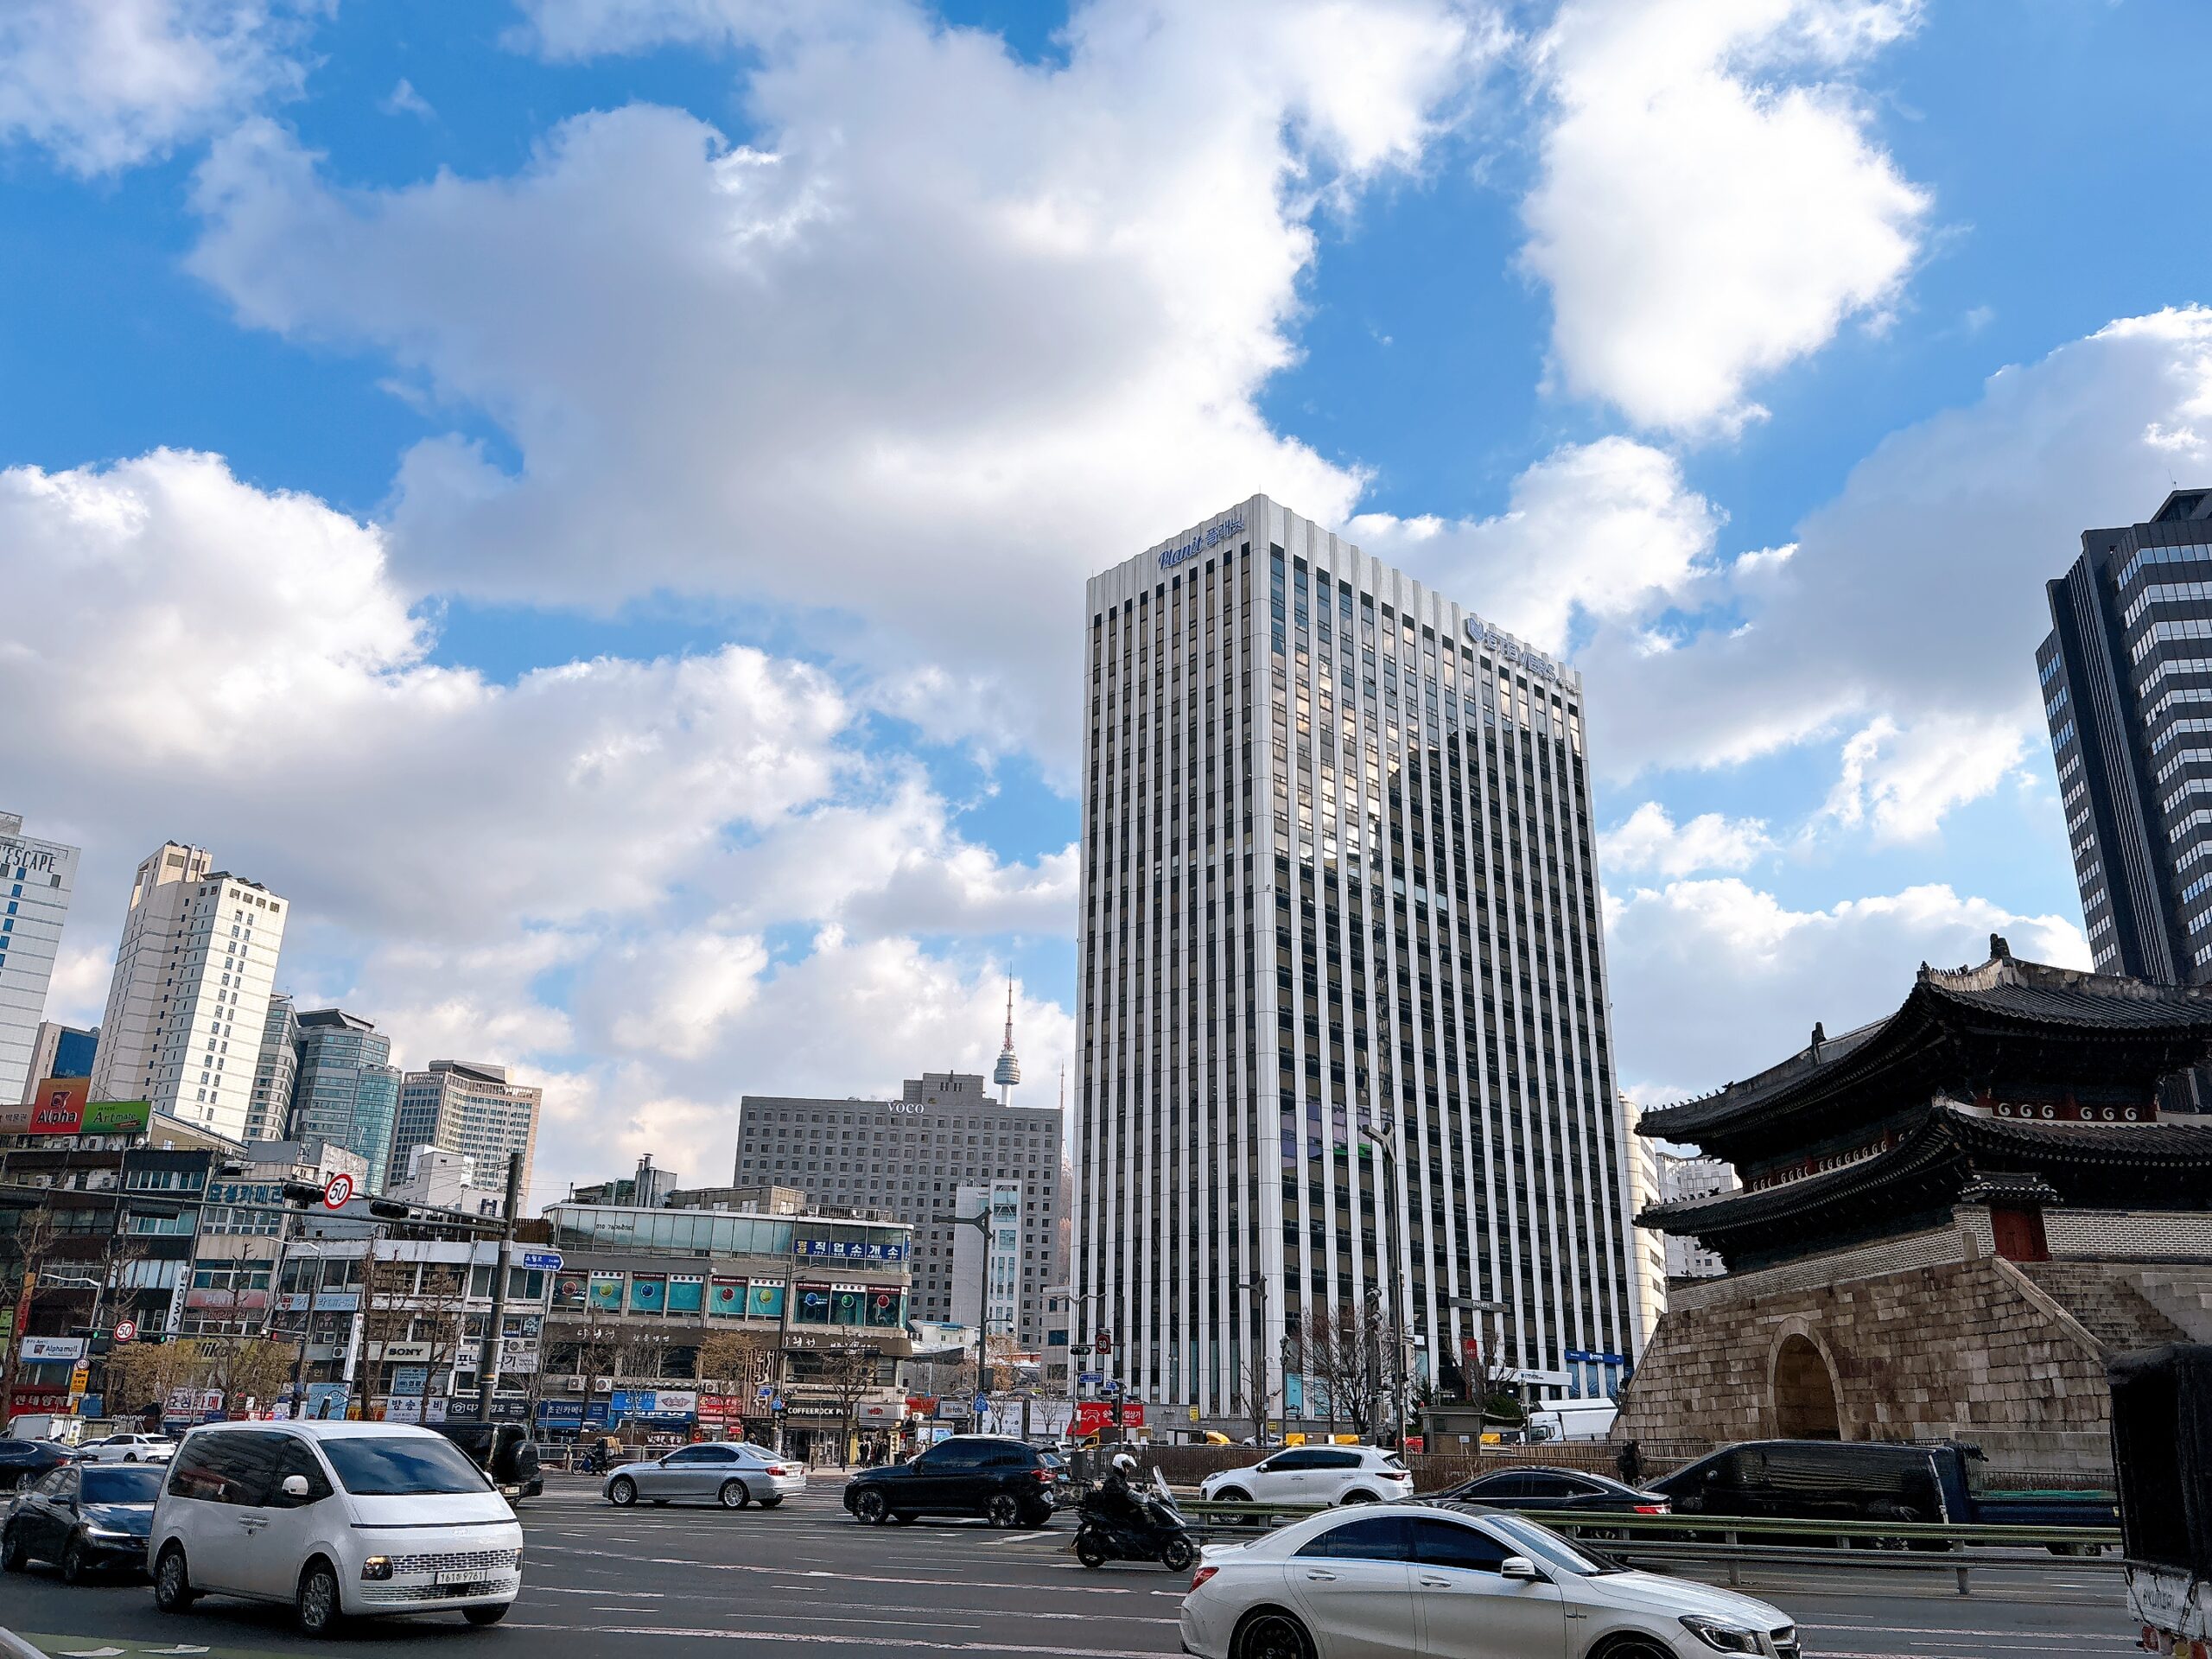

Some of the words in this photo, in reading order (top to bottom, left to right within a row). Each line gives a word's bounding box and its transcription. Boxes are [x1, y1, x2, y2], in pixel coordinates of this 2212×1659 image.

[1159, 535, 1203, 570] Planit
[1205, 513, 1244, 548] 플래닛
[0, 845, 57, 873] 'ESCAPE
[37, 1109, 77, 1125] Alpha
[329, 1182, 347, 1200] 50
[815, 1241, 899, 1256] 직업소개소
[171, 1270, 188, 1327] SIGMA
[118, 1325, 131, 1337] 50
[1098, 1339, 1107, 1349] 50
[391, 1399, 443, 1412] 방송비
[787, 1406, 834, 1416] COFFEEROCK
